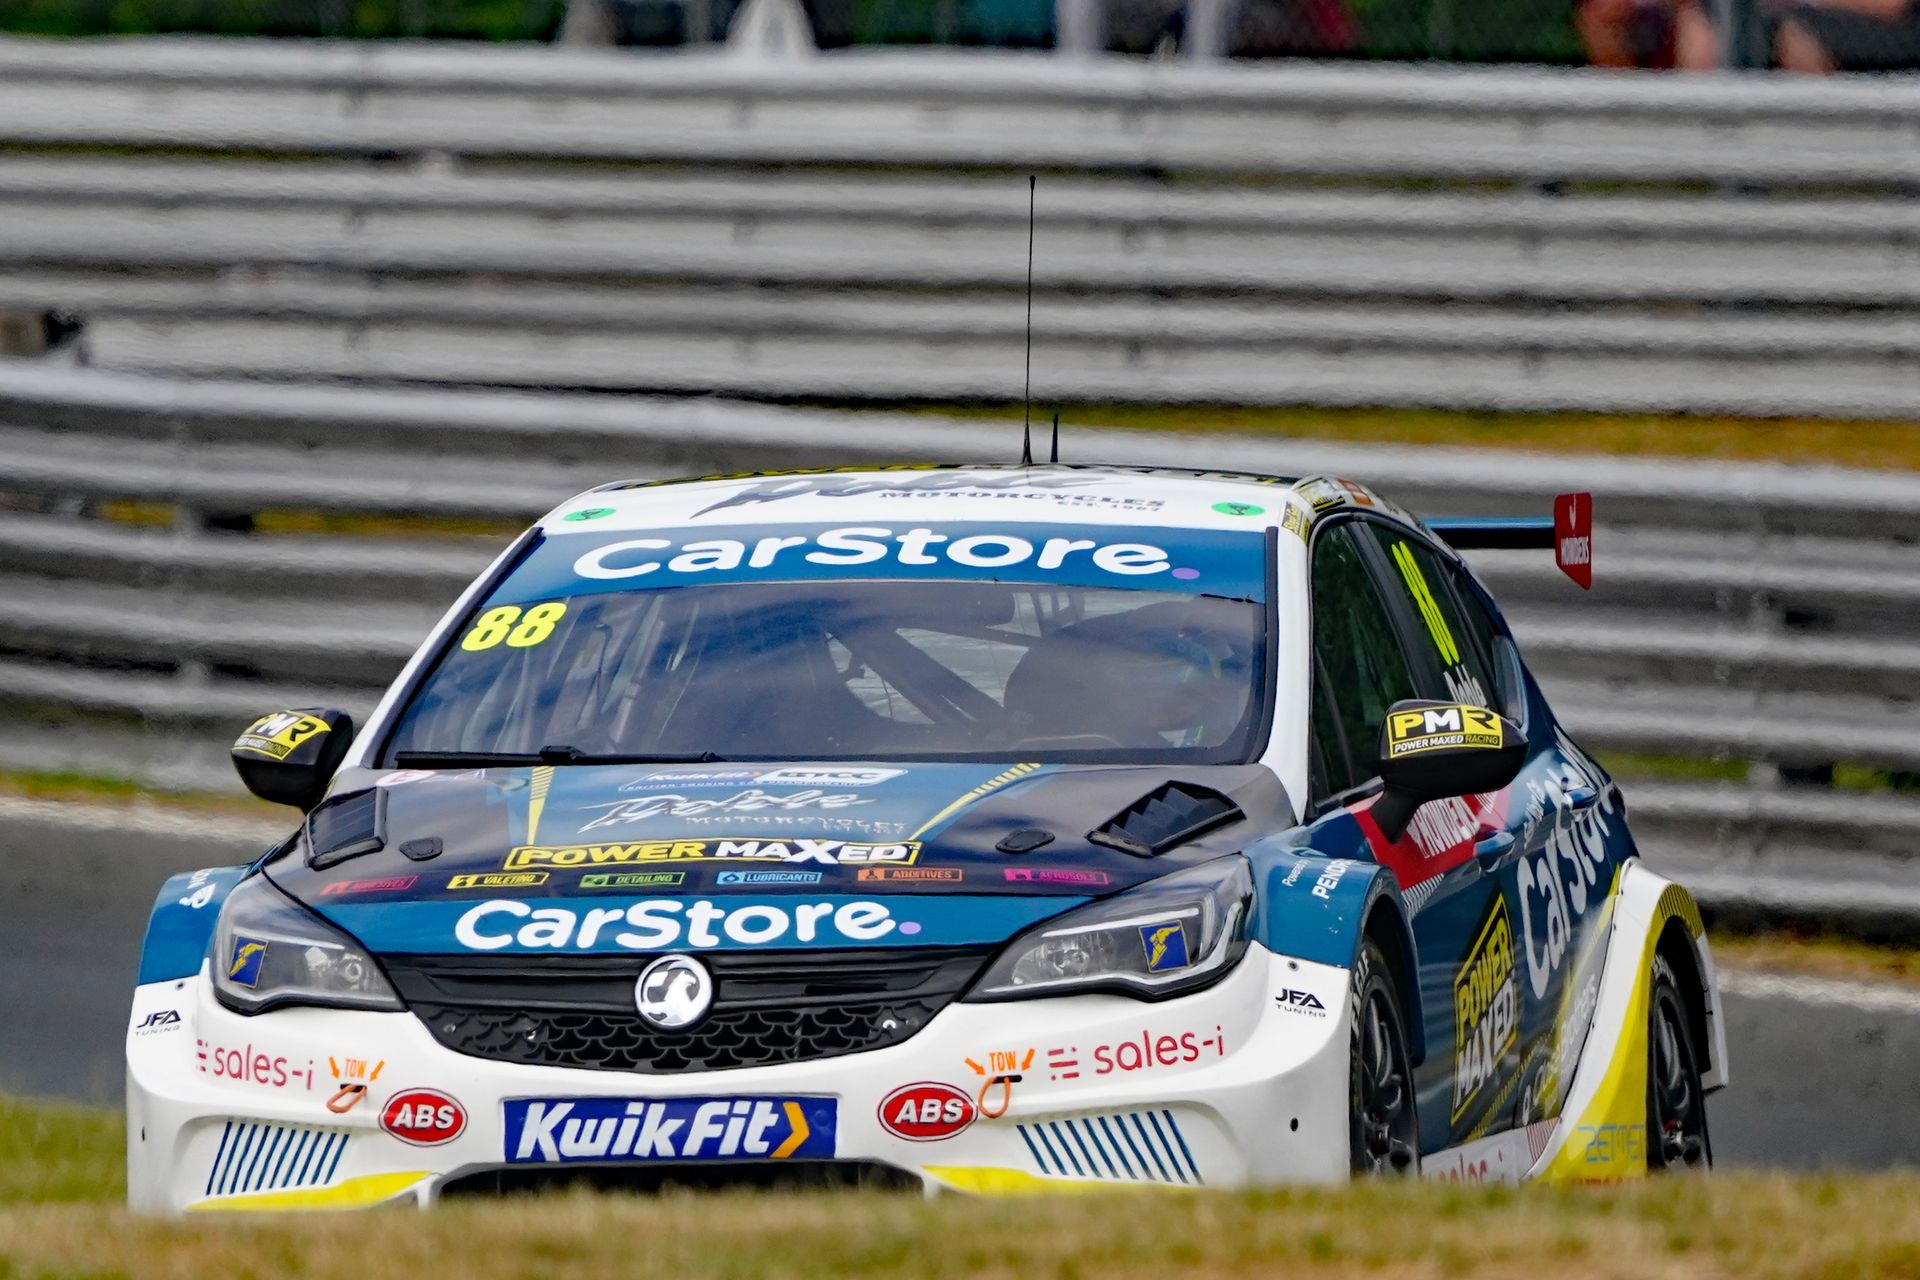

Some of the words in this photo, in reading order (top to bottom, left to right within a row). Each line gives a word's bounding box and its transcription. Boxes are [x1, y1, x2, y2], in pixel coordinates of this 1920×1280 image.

[880, 492, 1166, 507] MOTORCYCLES
[461, 602, 567, 651] 88
[1393, 708, 1497, 738] PMR
[1394, 738, 1428, 753] POWER
[1430, 735, 1464, 747] MAXED
[1465, 734, 1498, 745] RACING
[517, 842, 706, 865] POWER
[715, 839, 910, 864] MAXED
[484, 873, 534, 885] VALETING
[616, 873, 673, 884] DETAILING
[747, 872, 816, 882] LUBRICANTS
[893, 870, 952, 879] ADDITIVES
[1458, 917, 1513, 1050] POWER
[1275, 988, 1326, 1010] JFA
[137, 1009, 182, 1028] JFA
[1276, 1004, 1327, 1018] TUNING
[135, 1024, 181, 1036] TUNING
[1095, 1025, 1224, 1074] sales-i
[1456, 976, 1514, 1109] MAXED
[214, 1044, 314, 1090] sales-i
[345, 1058, 368, 1079] TOW
[989, 1052, 1016, 1073] TOW
[392, 1103, 455, 1130] ABS
[894, 1097, 965, 1125] ABS
